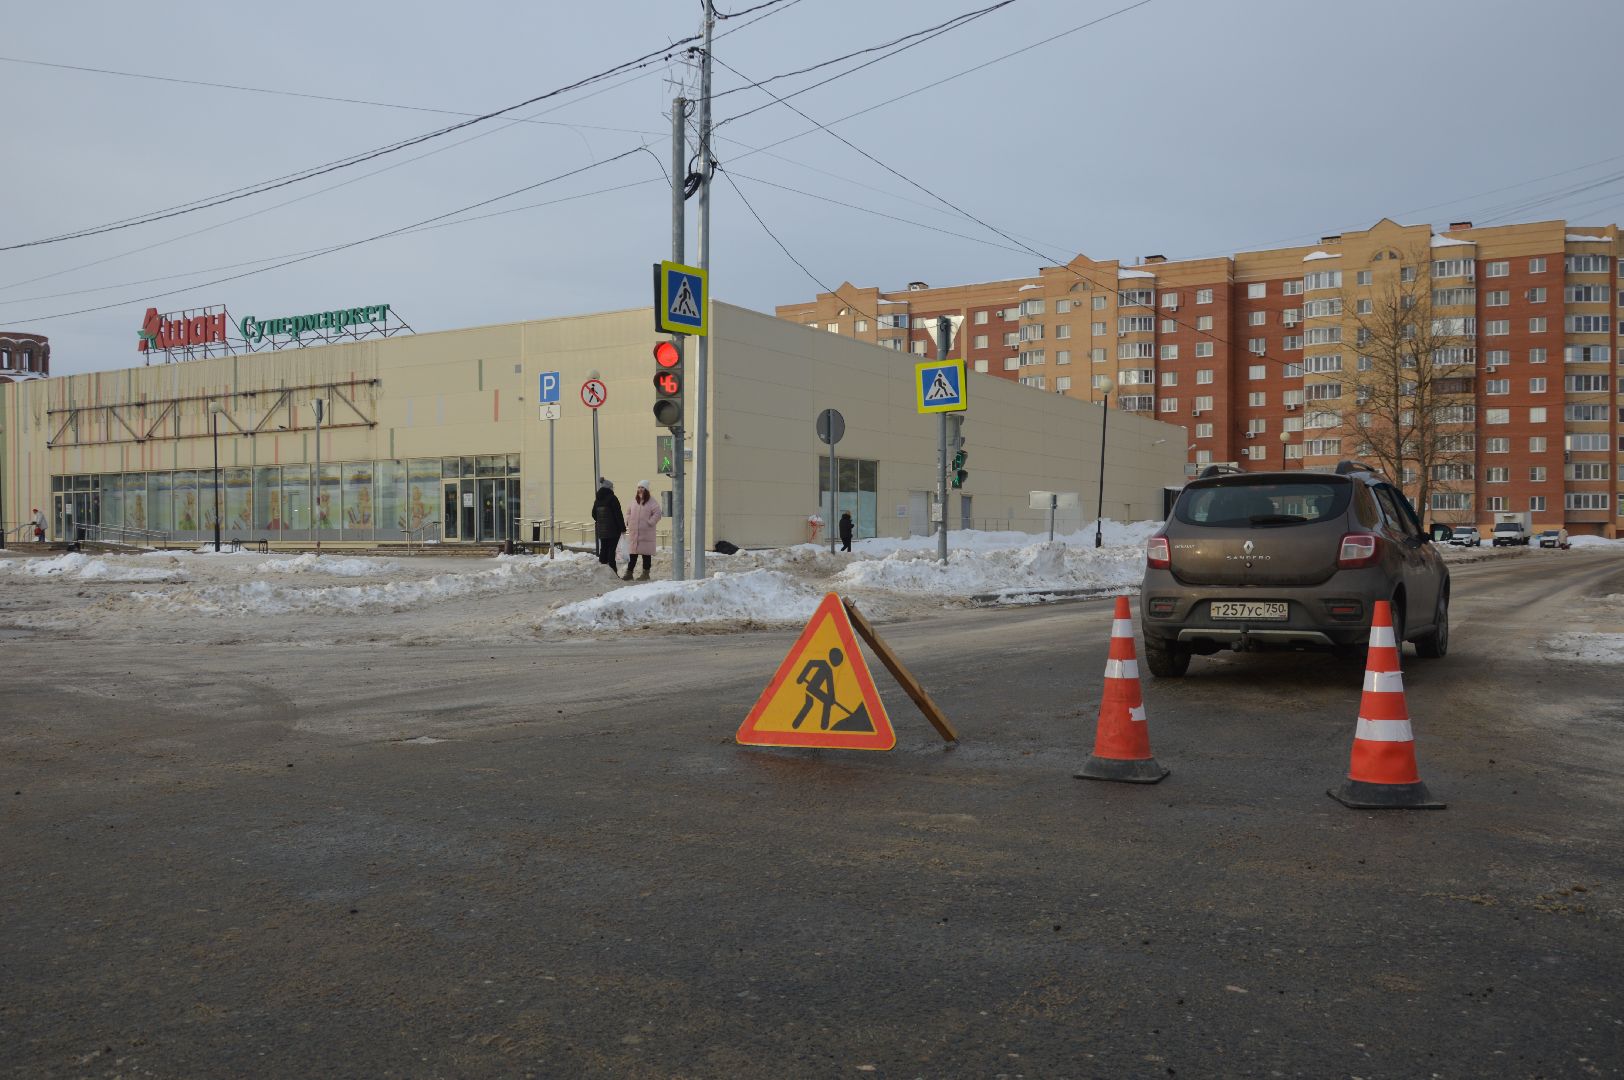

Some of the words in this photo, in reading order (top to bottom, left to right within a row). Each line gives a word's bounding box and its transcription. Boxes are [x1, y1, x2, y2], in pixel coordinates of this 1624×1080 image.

[138, 308, 225, 351] Ашан
[240, 304, 390, 343] Супермаркет
[543, 375, 556, 400] P
[660, 374, 678, 393] 46
